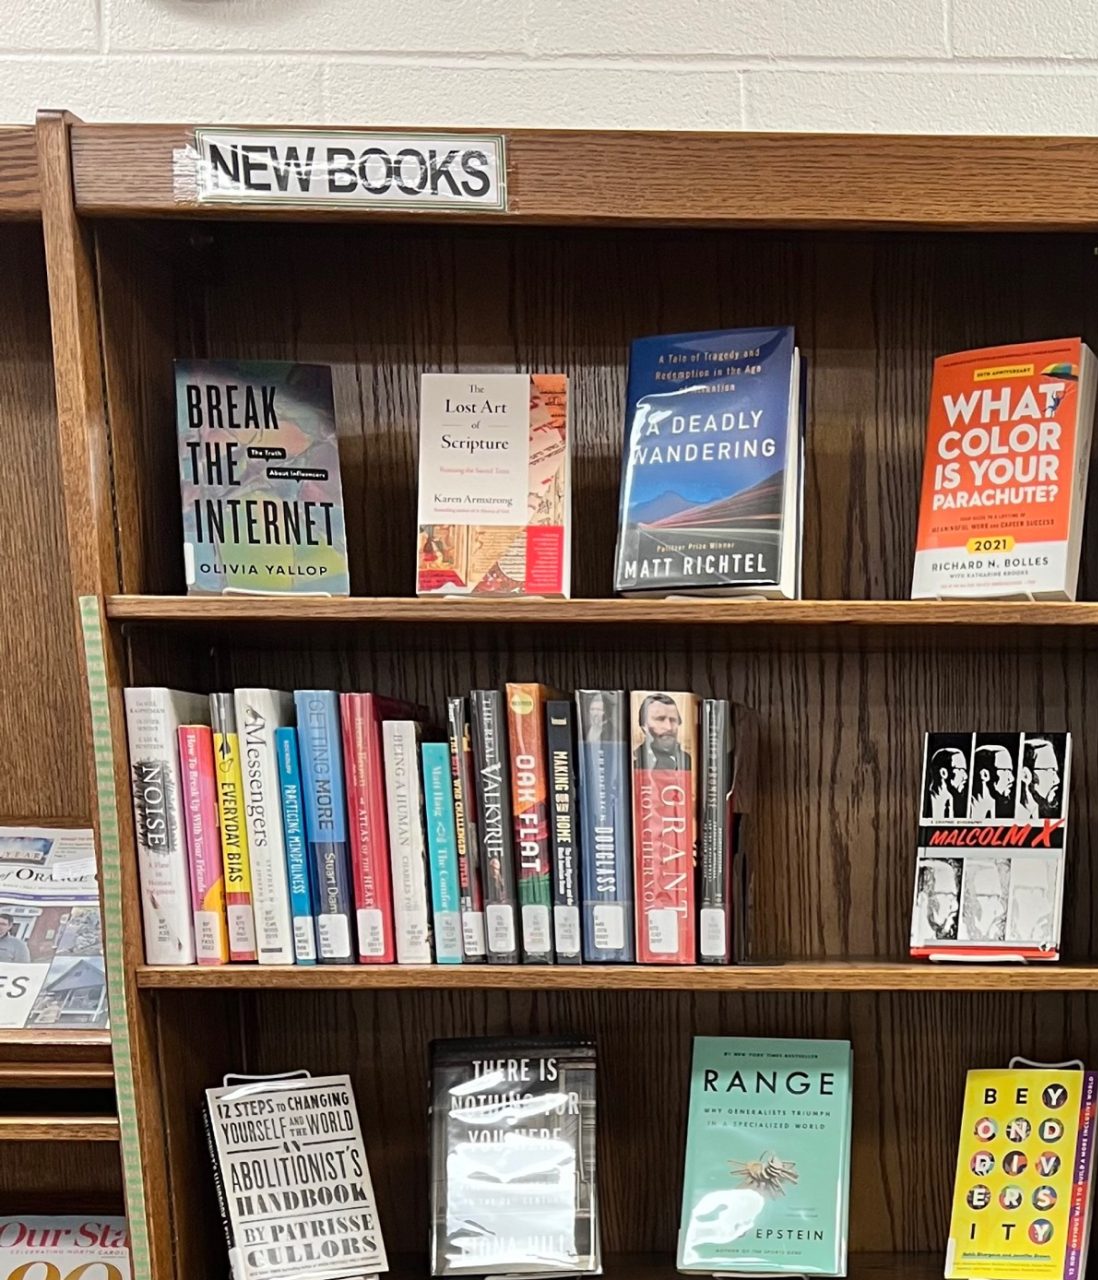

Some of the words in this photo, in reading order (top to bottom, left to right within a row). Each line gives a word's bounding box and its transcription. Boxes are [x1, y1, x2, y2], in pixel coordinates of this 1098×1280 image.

[209, 144, 315, 193] NEW
[327, 146, 491, 197] BOOKS
[469, 384, 485, 394] The
[186, 385, 279, 430] BREAK
[445, 399, 477, 414] Lost
[480, 401, 506, 414] Art
[943, 383, 1065, 426] WHAT
[471, 420, 480, 430] of
[647, 422, 660, 436] A
[672, 410, 764, 433] DEADLY
[441, 435, 509, 454] Scripture
[632, 439, 776, 465] WANDERING
[938, 422, 1061, 459] COLOR
[186, 442, 241, 486] THE
[935, 463, 964, 489] IS
[971, 455, 1059, 486] YOUR
[434, 494, 461, 504] Karen
[464, 494, 513, 508] Armstrong
[932, 485, 1059, 510] PARACHUTE?
[195, 500, 334, 546] INTERNET
[975, 538, 1008, 552] 2021
[200, 563, 258, 575] OLIVIA
[265, 565, 328, 576] YALLOP
[625, 557, 678, 579] MATT
[683, 553, 767, 575] RICHTEL
[931, 558, 982, 572] RICHARD
[986, 558, 1000, 569] N.
[1004, 556, 1049, 568] BOLLES
[244, 704, 268, 848] Messengers
[516, 754, 536, 801] OAK
[142, 766, 166, 846] NOISE
[220, 782, 240, 849] EVERYDAY
[480, 762, 503, 858] VALKYRIE
[520, 814, 540, 871] FLAT
[929, 824, 1030, 847] MALCOLM
[1031, 818, 1065, 848] X
[594, 827, 616, 892] DOUGLASS
[660, 784, 688, 918] GRANT
[227, 852, 242, 882] BIAS
[703, 1070, 835, 1096] RANGE
[217, 1105, 232, 1119] 12
[234, 1100, 274, 1118] STEPS
[276, 1103, 286, 1112] TO
[289, 1092, 349, 1110] CHANGING
[221, 1113, 288, 1144] YOURSELF
[289, 1116, 304, 1127] AND
[289, 1127, 308, 1136] THE
[308, 1110, 354, 1134] WORLD
[282, 1141, 301, 1153] AN
[230, 1146, 363, 1192] ABOLITIONIST'S
[236, 1182, 367, 1216] HANDBOOK
[244, 1228, 266, 1243] BY
[271, 1214, 374, 1241] PATRISSE
[755, 1228, 825, 1241] EPSTEIN
[247, 1236, 377, 1268] CULLORS
